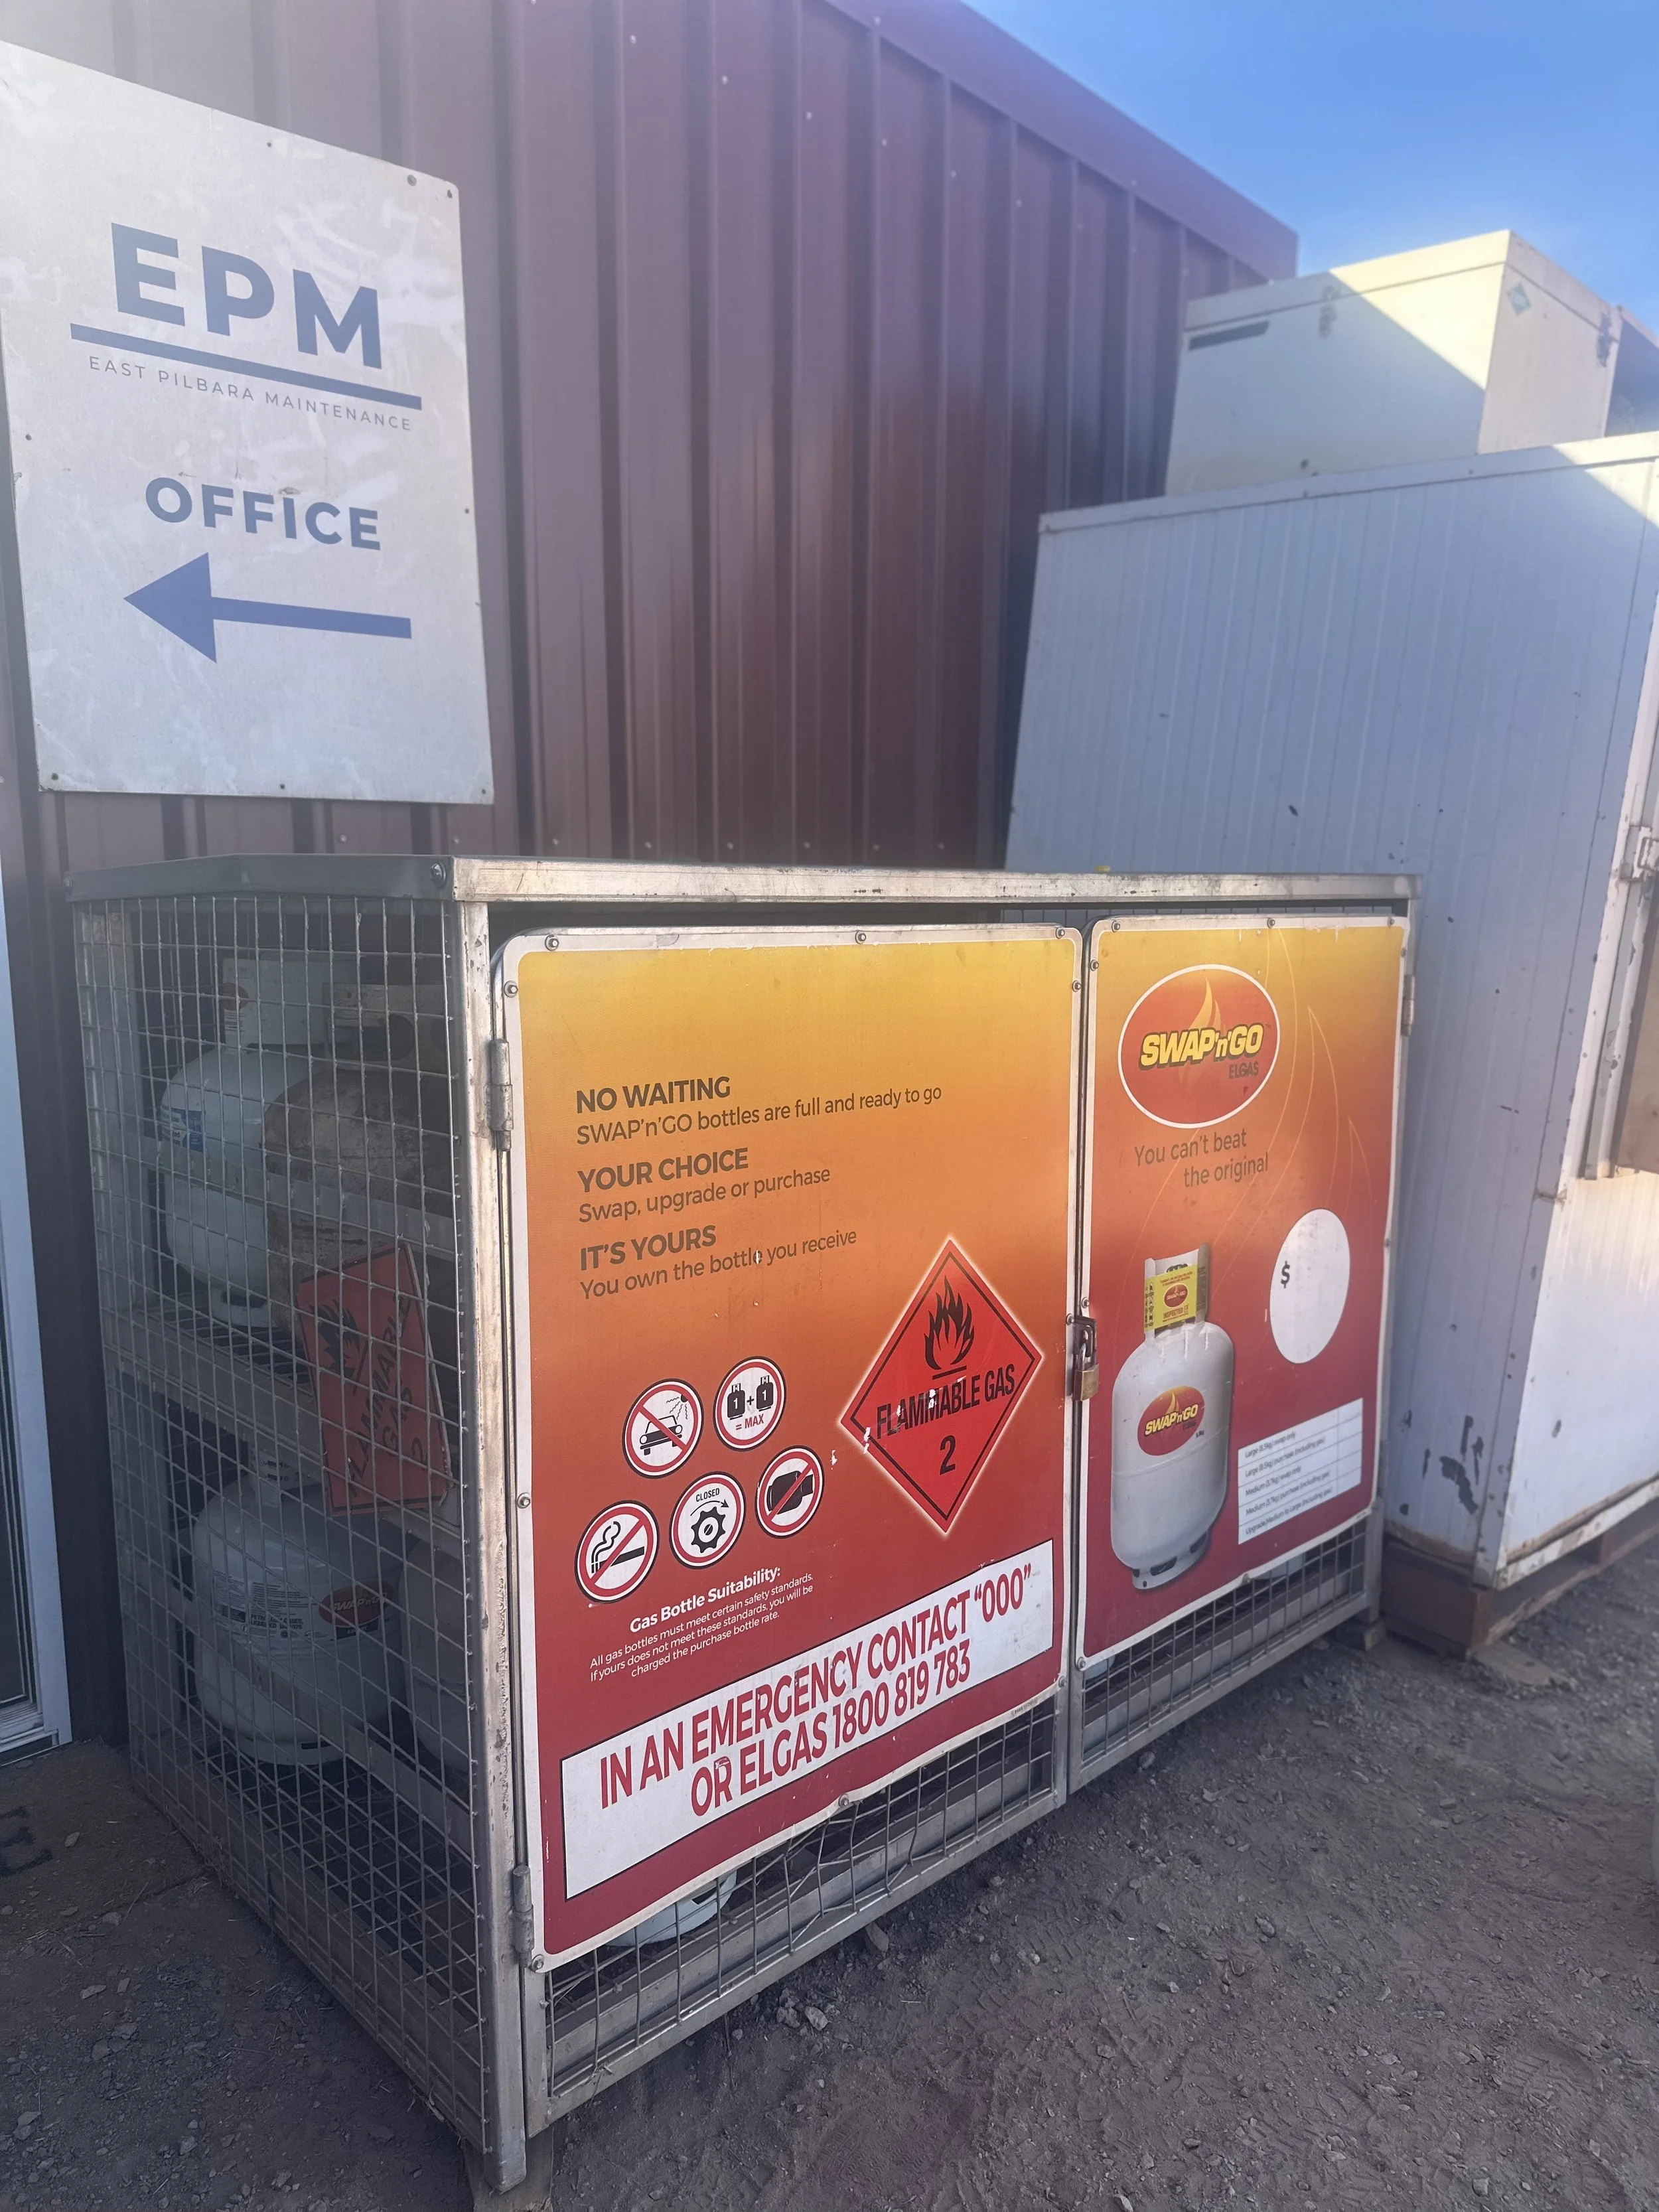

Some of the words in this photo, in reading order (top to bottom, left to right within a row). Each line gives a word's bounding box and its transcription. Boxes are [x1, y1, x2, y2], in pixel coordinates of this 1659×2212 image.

[111, 222, 382, 370] EPM
[89, 356, 146, 379] EAST
[159, 370, 254, 402] PILBARA
[265, 392, 412, 431] MAINTENANCE
[145, 477, 382, 551] OFFICE
[1228, 1060, 1259, 1080] ELGAS
[576, 1088, 618, 1114] NO
[622, 1076, 731, 1108] WAITING
[698, 1106, 760, 1130] bottles
[764, 1105, 791, 1122] are
[794, 1097, 820, 1118] full
[824, 1093, 855, 1114] and
[859, 1088, 902, 1110] ready
[904, 1088, 920, 1103] to
[923, 1087, 942, 1105] go
[1134, 1145, 1165, 1167] You
[1171, 1134, 1209, 1160] can't
[1214, 1128, 1247, 1153] beat
[1184, 1165, 1210, 1188] the
[1214, 1151, 1269, 1183] original
[577, 1161, 653, 1193] YOUR
[658, 1147, 749, 1181] CHOICE
[579, 1199, 641, 1223] Swap,
[646, 1182, 727, 1215] upgrade
[731, 1180, 749, 1198] or
[754, 1168, 831, 1196] purchase
[579, 1279, 619, 1299] You
[624, 1268, 668, 1291] own
[673, 1260, 705, 1281] the
[709, 1247, 763, 1274] bottle
[766, 1242, 797, 1266] you
[802, 1229, 857, 1254] receive
[580, 1241, 626, 1271] IT'S
[631, 1224, 717, 1261] YOURS
[1280, 1260, 1291, 1289] $
[745, 1414, 764, 1430] MAX
[877, 1374, 981, 1439] FLAMMABLE
[984, 1363, 1015, 1402] GAS
[939, 1434, 956, 1475] 2
[1245, 1447, 1258, 1458] Large
[1274, 1436, 1286, 1446] swap
[1286, 1431, 1296, 1441] only
[1245, 1467, 1258, 1477] Large
[1274, 1450, 1294, 1465] purchase
[695, 1487, 720, 1503] CLOSED
[1245, 1482, 1265, 1497] Medium
[1280, 1469, 1291, 1480] swap
[1291, 1465, 1301, 1475] only
[1246, 1502, 1265, 1516] Medium
[1280, 1485, 1299, 1500] purchase
[1266, 1510, 1284, 1524] Medium
[589, 1654, 603, 1669] All
[605, 1649, 623, 1664] gas
[624, 1634, 658, 1655] bottles
[660, 1623, 684, 1641] must
[686, 1613, 711, 1629] meet
[712, 1599, 743, 1619] certain
[744, 1590, 770, 1607] safety
[770, 1572, 814, 1596] standards.
[630, 1613, 658, 1633] Gas
[661, 1594, 705, 1622] Bottle
[707, 1566, 781, 1603] Suitability:
[590, 1670, 599, 1682] If
[599, 1660, 626, 1681] yours
[627, 1649, 651, 1666] does
[652, 1641, 669, 1656] not
[670, 1631, 695, 1649] meet
[697, 1621, 722, 1637] these
[723, 1603, 768, 1627] standards,
[768, 1596, 785, 1611] you
[786, 1589, 801, 1601] will
[802, 1584, 814, 1595] be
[631, 1652, 671, 1678] charged
[672, 1647, 688, 1660] the
[690, 1629, 732, 1655] purchase
[733, 1618, 760, 1635] bottle
[761, 1611, 780, 1625] rate.
[600, 1745, 632, 1810] IN
[639, 1720, 684, 1791] AN
[691, 1641, 863, 1765] EMERGENCY
[867, 1589, 971, 1680] CONTACT
[691, 1755, 733, 1817] OR
[740, 1711, 828, 1796] ELGAS
[832, 1682, 890, 1749] 1800
[894, 1660, 930, 1718] 819
[934, 1638, 971, 1696] 783
